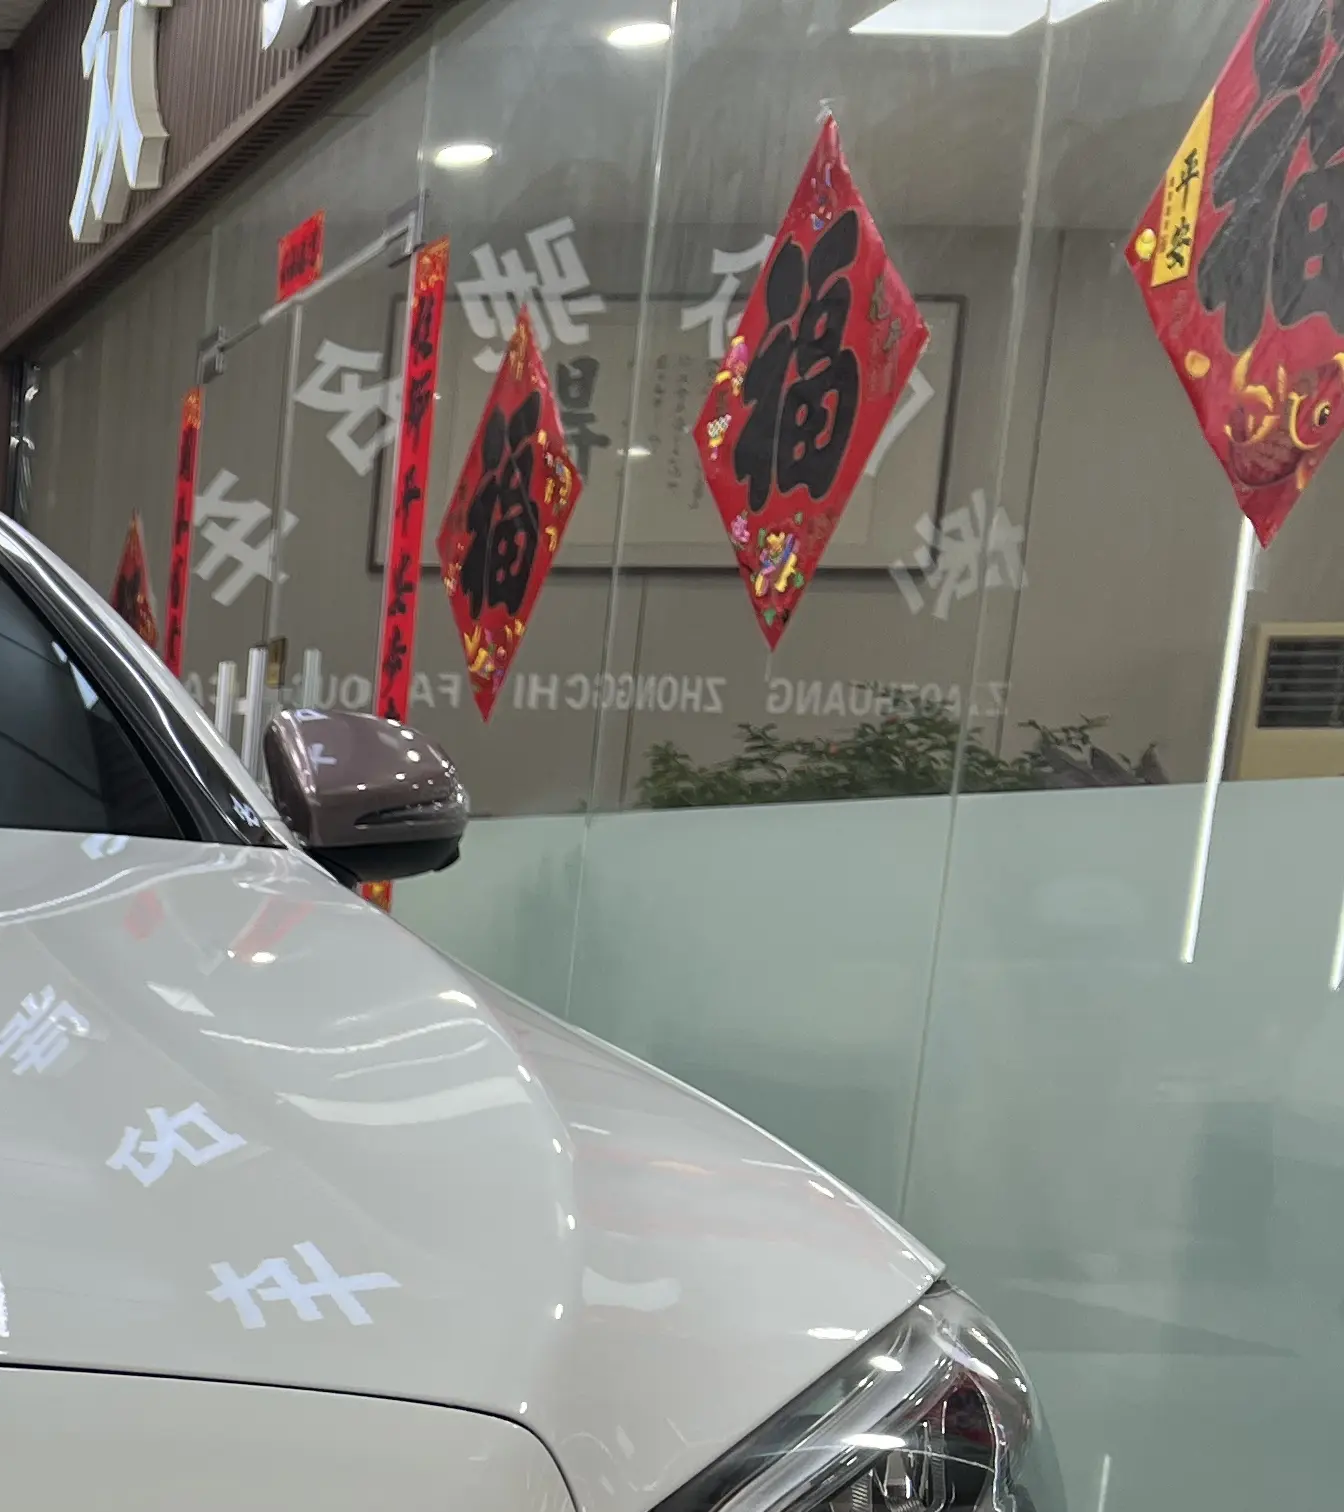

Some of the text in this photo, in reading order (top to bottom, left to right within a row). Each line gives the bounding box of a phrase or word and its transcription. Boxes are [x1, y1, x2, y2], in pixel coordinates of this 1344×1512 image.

[1166, 148, 1200, 269] 平安
[732, 208, 861, 513] 福
[460, 389, 543, 620] 福
